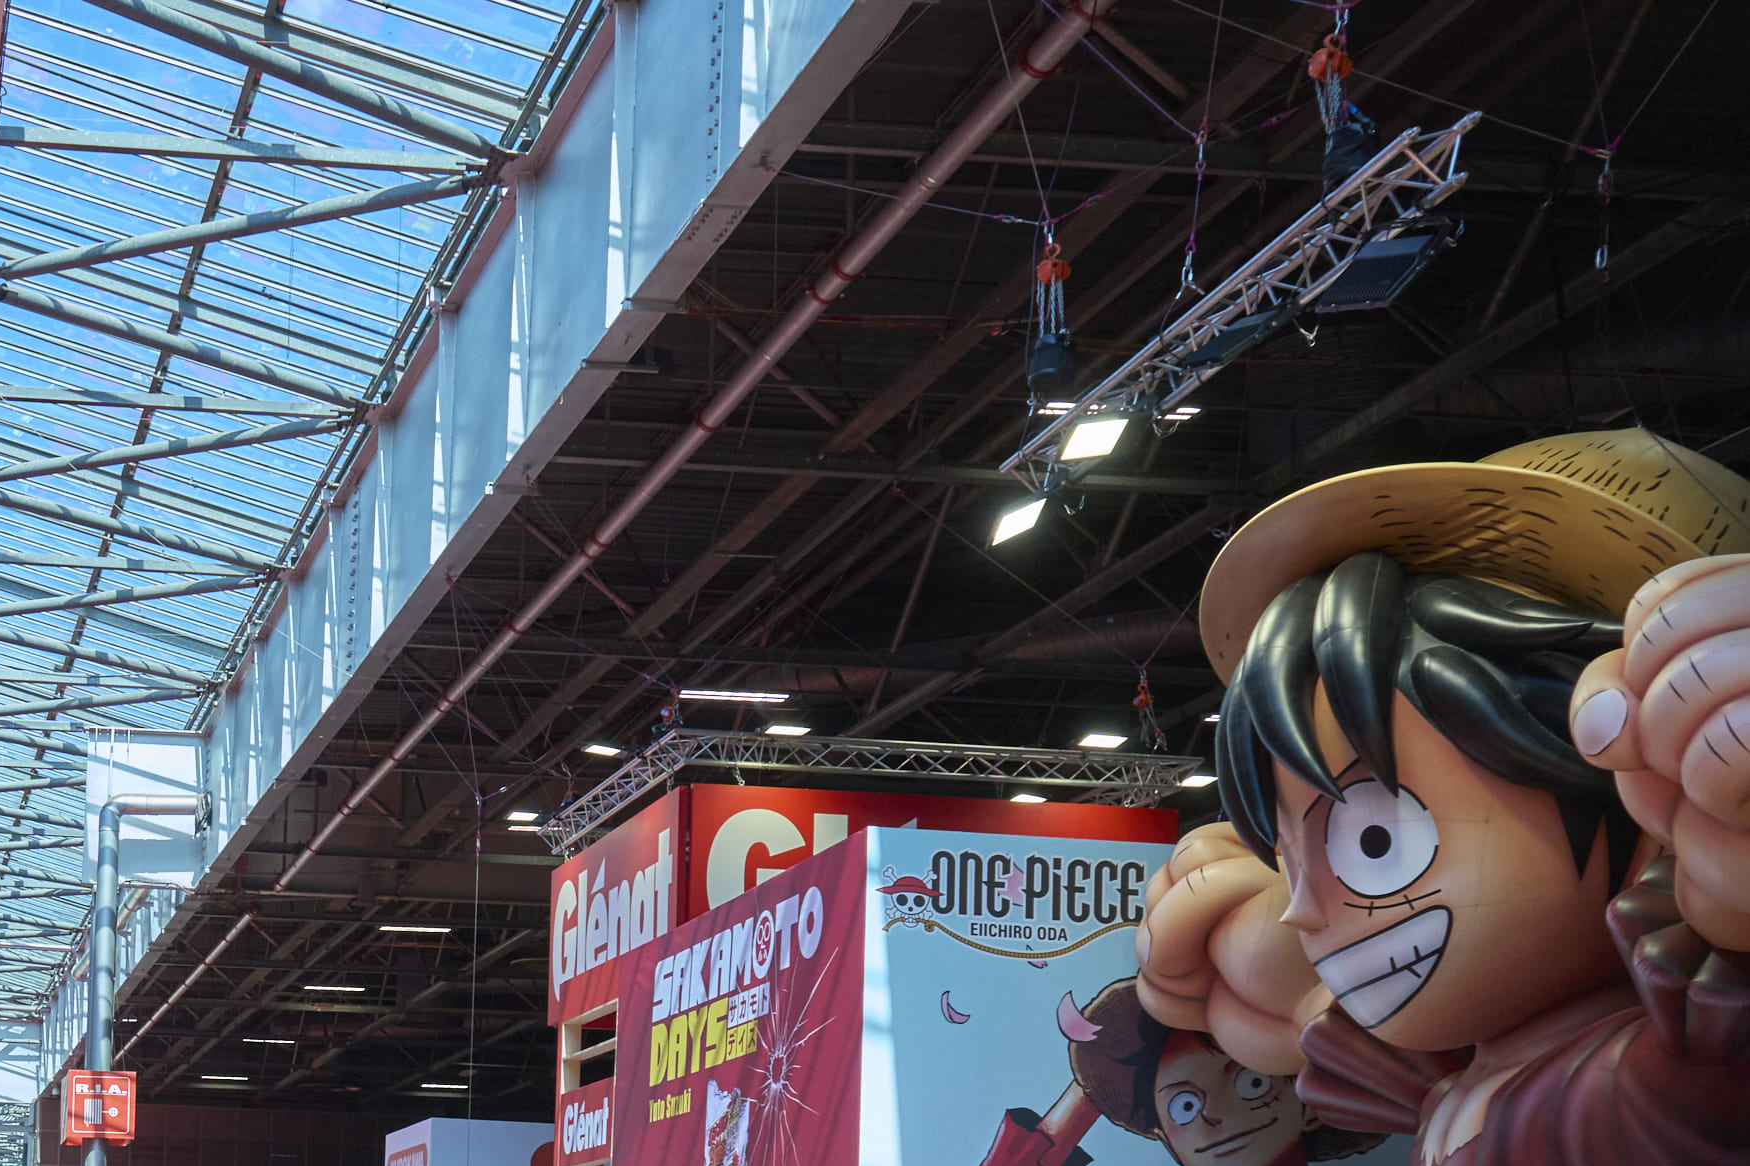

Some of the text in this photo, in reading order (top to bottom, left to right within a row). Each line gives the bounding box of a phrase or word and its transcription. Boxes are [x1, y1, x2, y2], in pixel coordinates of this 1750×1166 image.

[552, 828, 673, 1001] Glénat
[932, 850, 1012, 918] ONE
[652, 886, 824, 1023] SAKAMOTO
[970, 922, 1068, 942] EIICHIRO ODA
[650, 997, 728, 1087] DAYS
[76, 1082, 128, 1096] R.I.A.
[563, 1097, 609, 1155] Glénat
